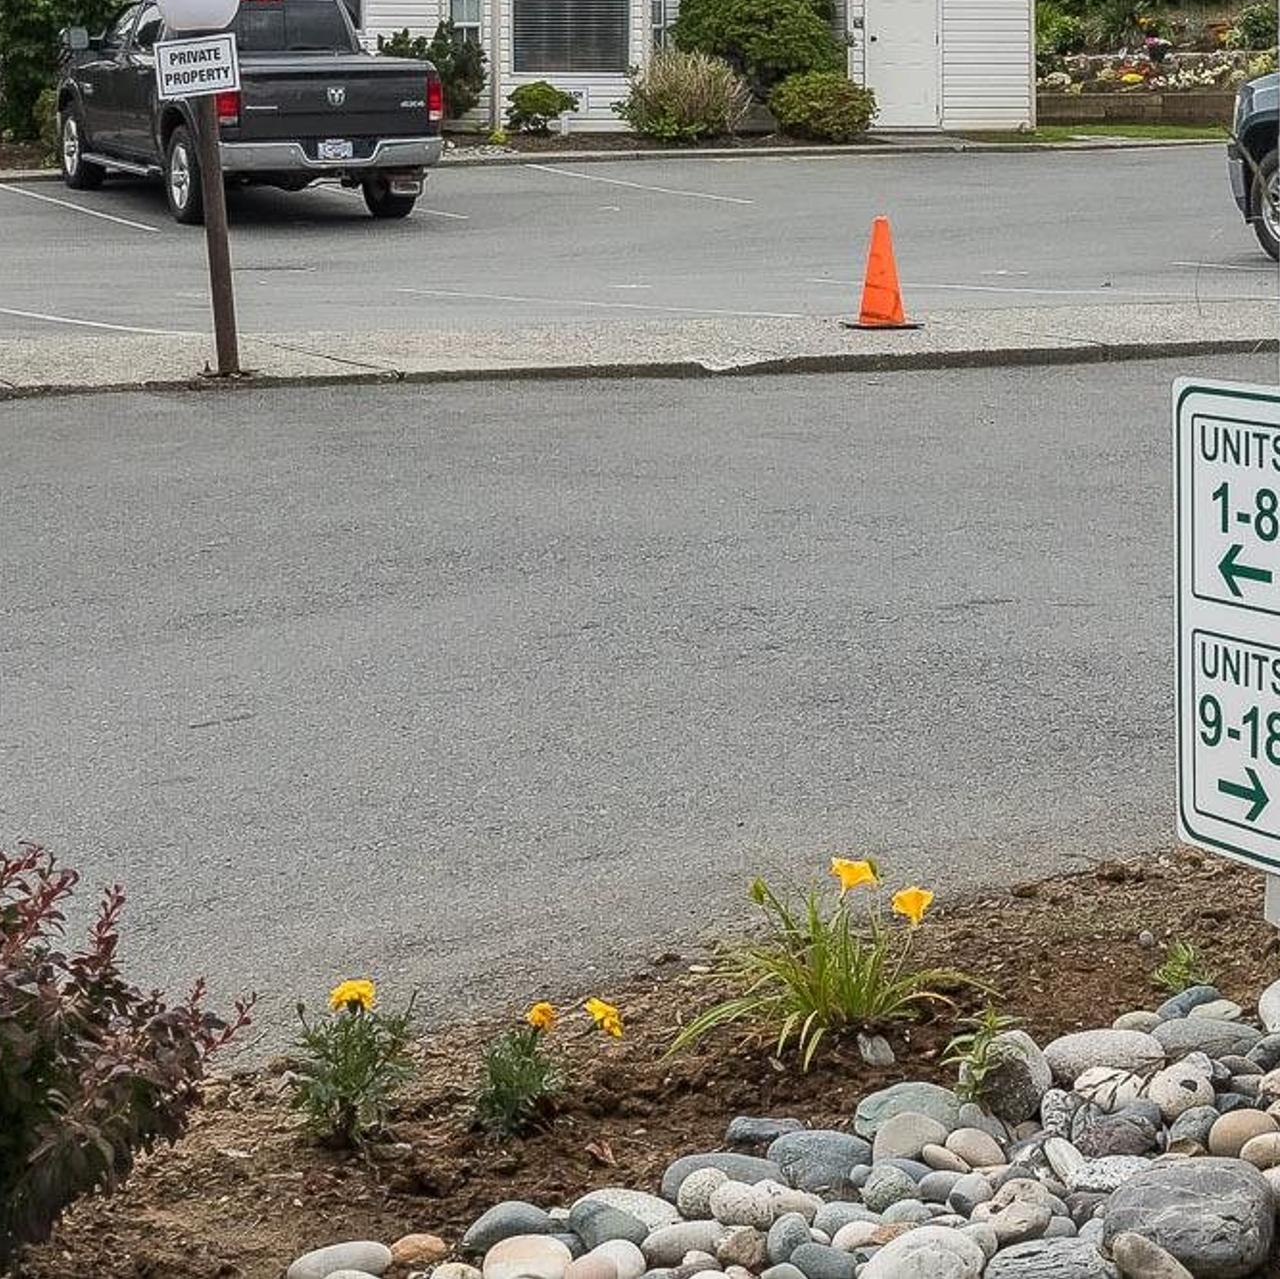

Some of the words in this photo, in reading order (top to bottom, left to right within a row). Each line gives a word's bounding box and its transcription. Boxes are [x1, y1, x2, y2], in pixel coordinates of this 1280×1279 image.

[169, 47, 221, 66] PRIVATE
[165, 66, 231, 86] PROPERTY
[1212, 481, 1279, 542] 1-8
